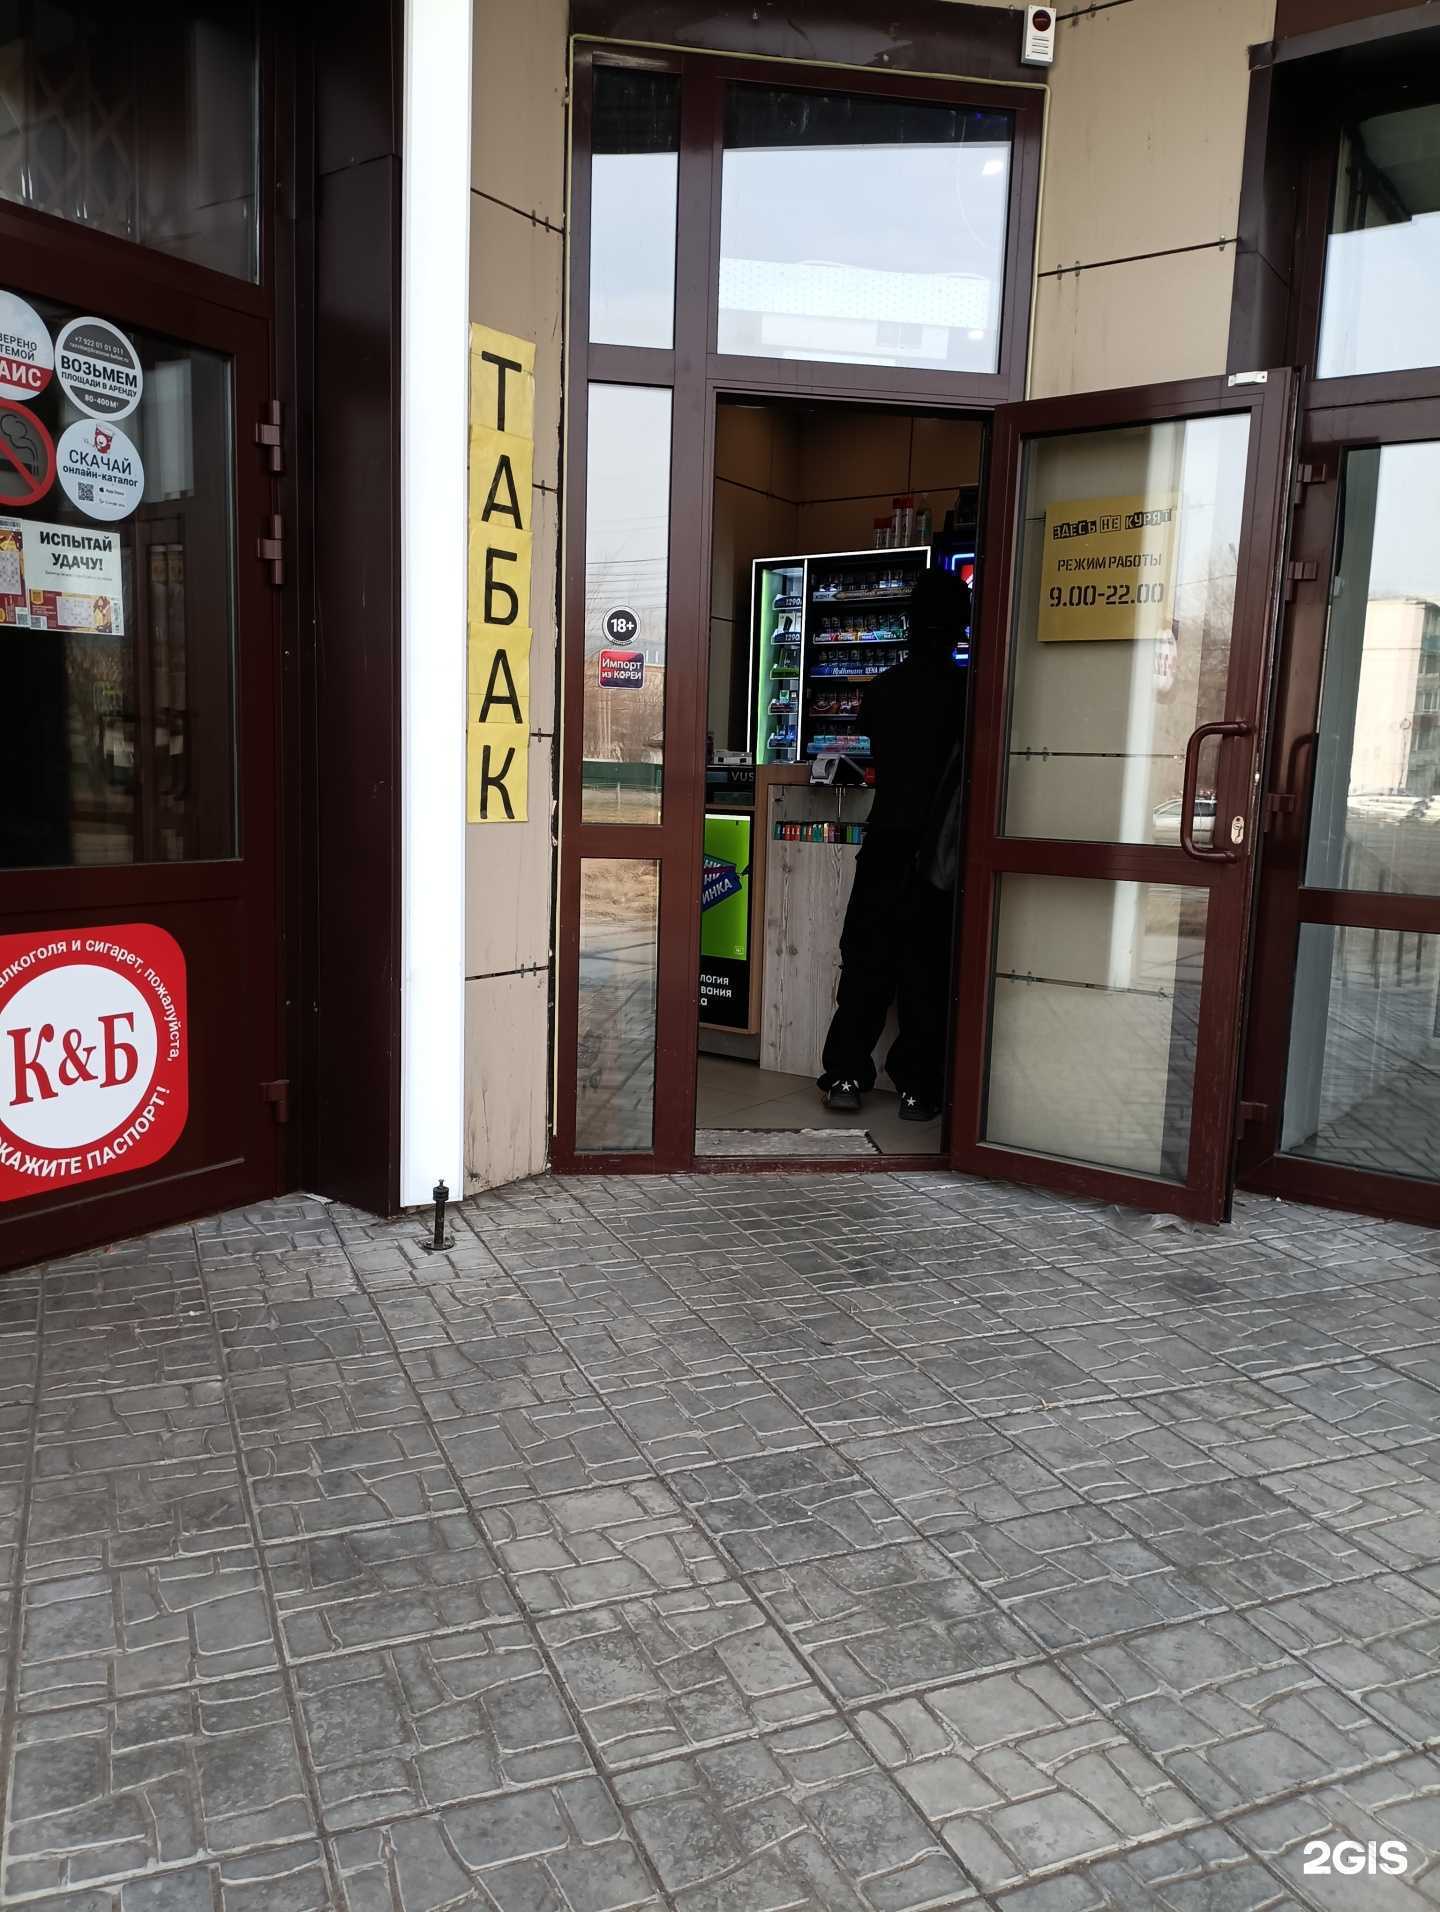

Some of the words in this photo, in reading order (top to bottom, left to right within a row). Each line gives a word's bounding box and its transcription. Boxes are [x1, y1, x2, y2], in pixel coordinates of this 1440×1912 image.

[0, 359, 41, 387] АИС
[61, 354, 138, 388] ВОЗЬМЕМ
[61, 371, 101, 389] ПЛОЩАДИ
[108, 384, 137, 398] АРЕНДУ
[69, 449, 132, 476] СКАЧАЙ
[63, 465, 139, 488] онлайн-каталог
[1053, 520, 1097, 540] ЗДЕСЬ
[1100, 515, 1121, 533] НЕ
[39, 531, 113, 552] ИСПЫТАЙ
[51, 552, 104, 572] УДАЧУ!
[1057, 556, 1106, 573] РЕЖИМ
[1108, 553, 1162, 569] РАБОТЫ
[478, 350, 523, 820] ТАБАК
[1049, 582, 1165, 608] 9.00-22.00
[610, 618, 634, 633] 18+
[602, 658, 641, 671] Импорт
[614, 671, 642, 680] КОРЕИ
[72, 939, 81, 951] и
[86, 939, 143, 973] сигарет,
[144, 967, 180, 1062] пожалуйста,
[7, 1011, 139, 1107] К&Б
[0, 1136, 82, 1178] КАЖИТЕ
[87, 1085, 170, 1170] ПАСПОРТ!
